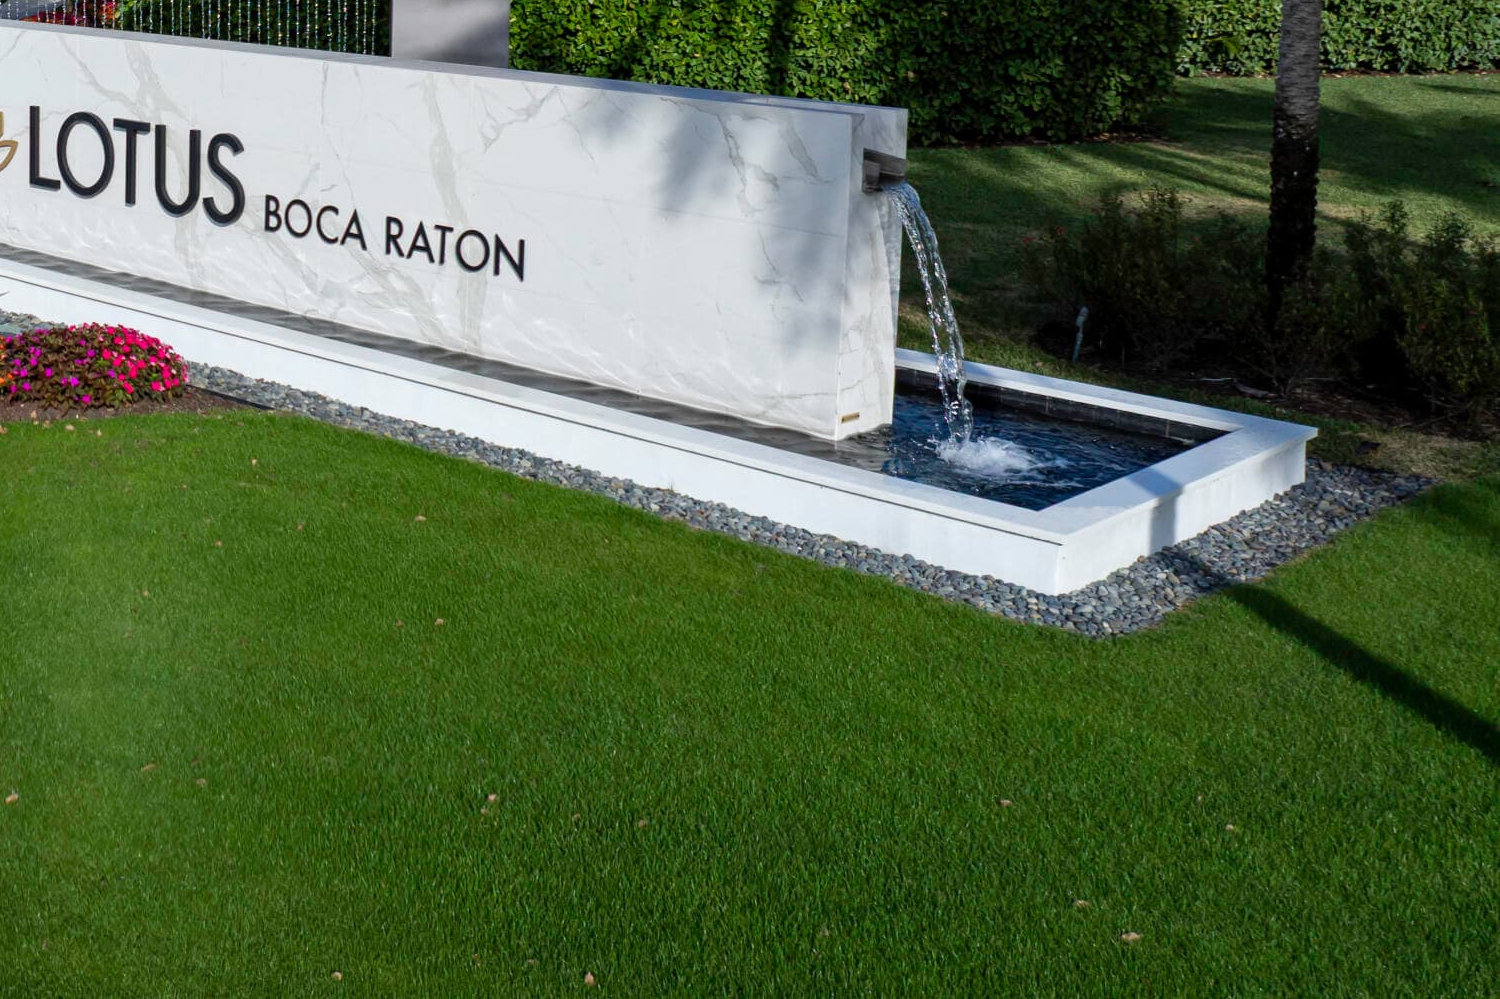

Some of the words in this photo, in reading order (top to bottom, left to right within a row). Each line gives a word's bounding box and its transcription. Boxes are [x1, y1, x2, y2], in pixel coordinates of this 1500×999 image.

[29, 105, 247, 227] LOTUS
[264, 194, 368, 252] BOCA
[384, 216, 526, 283] RATON
